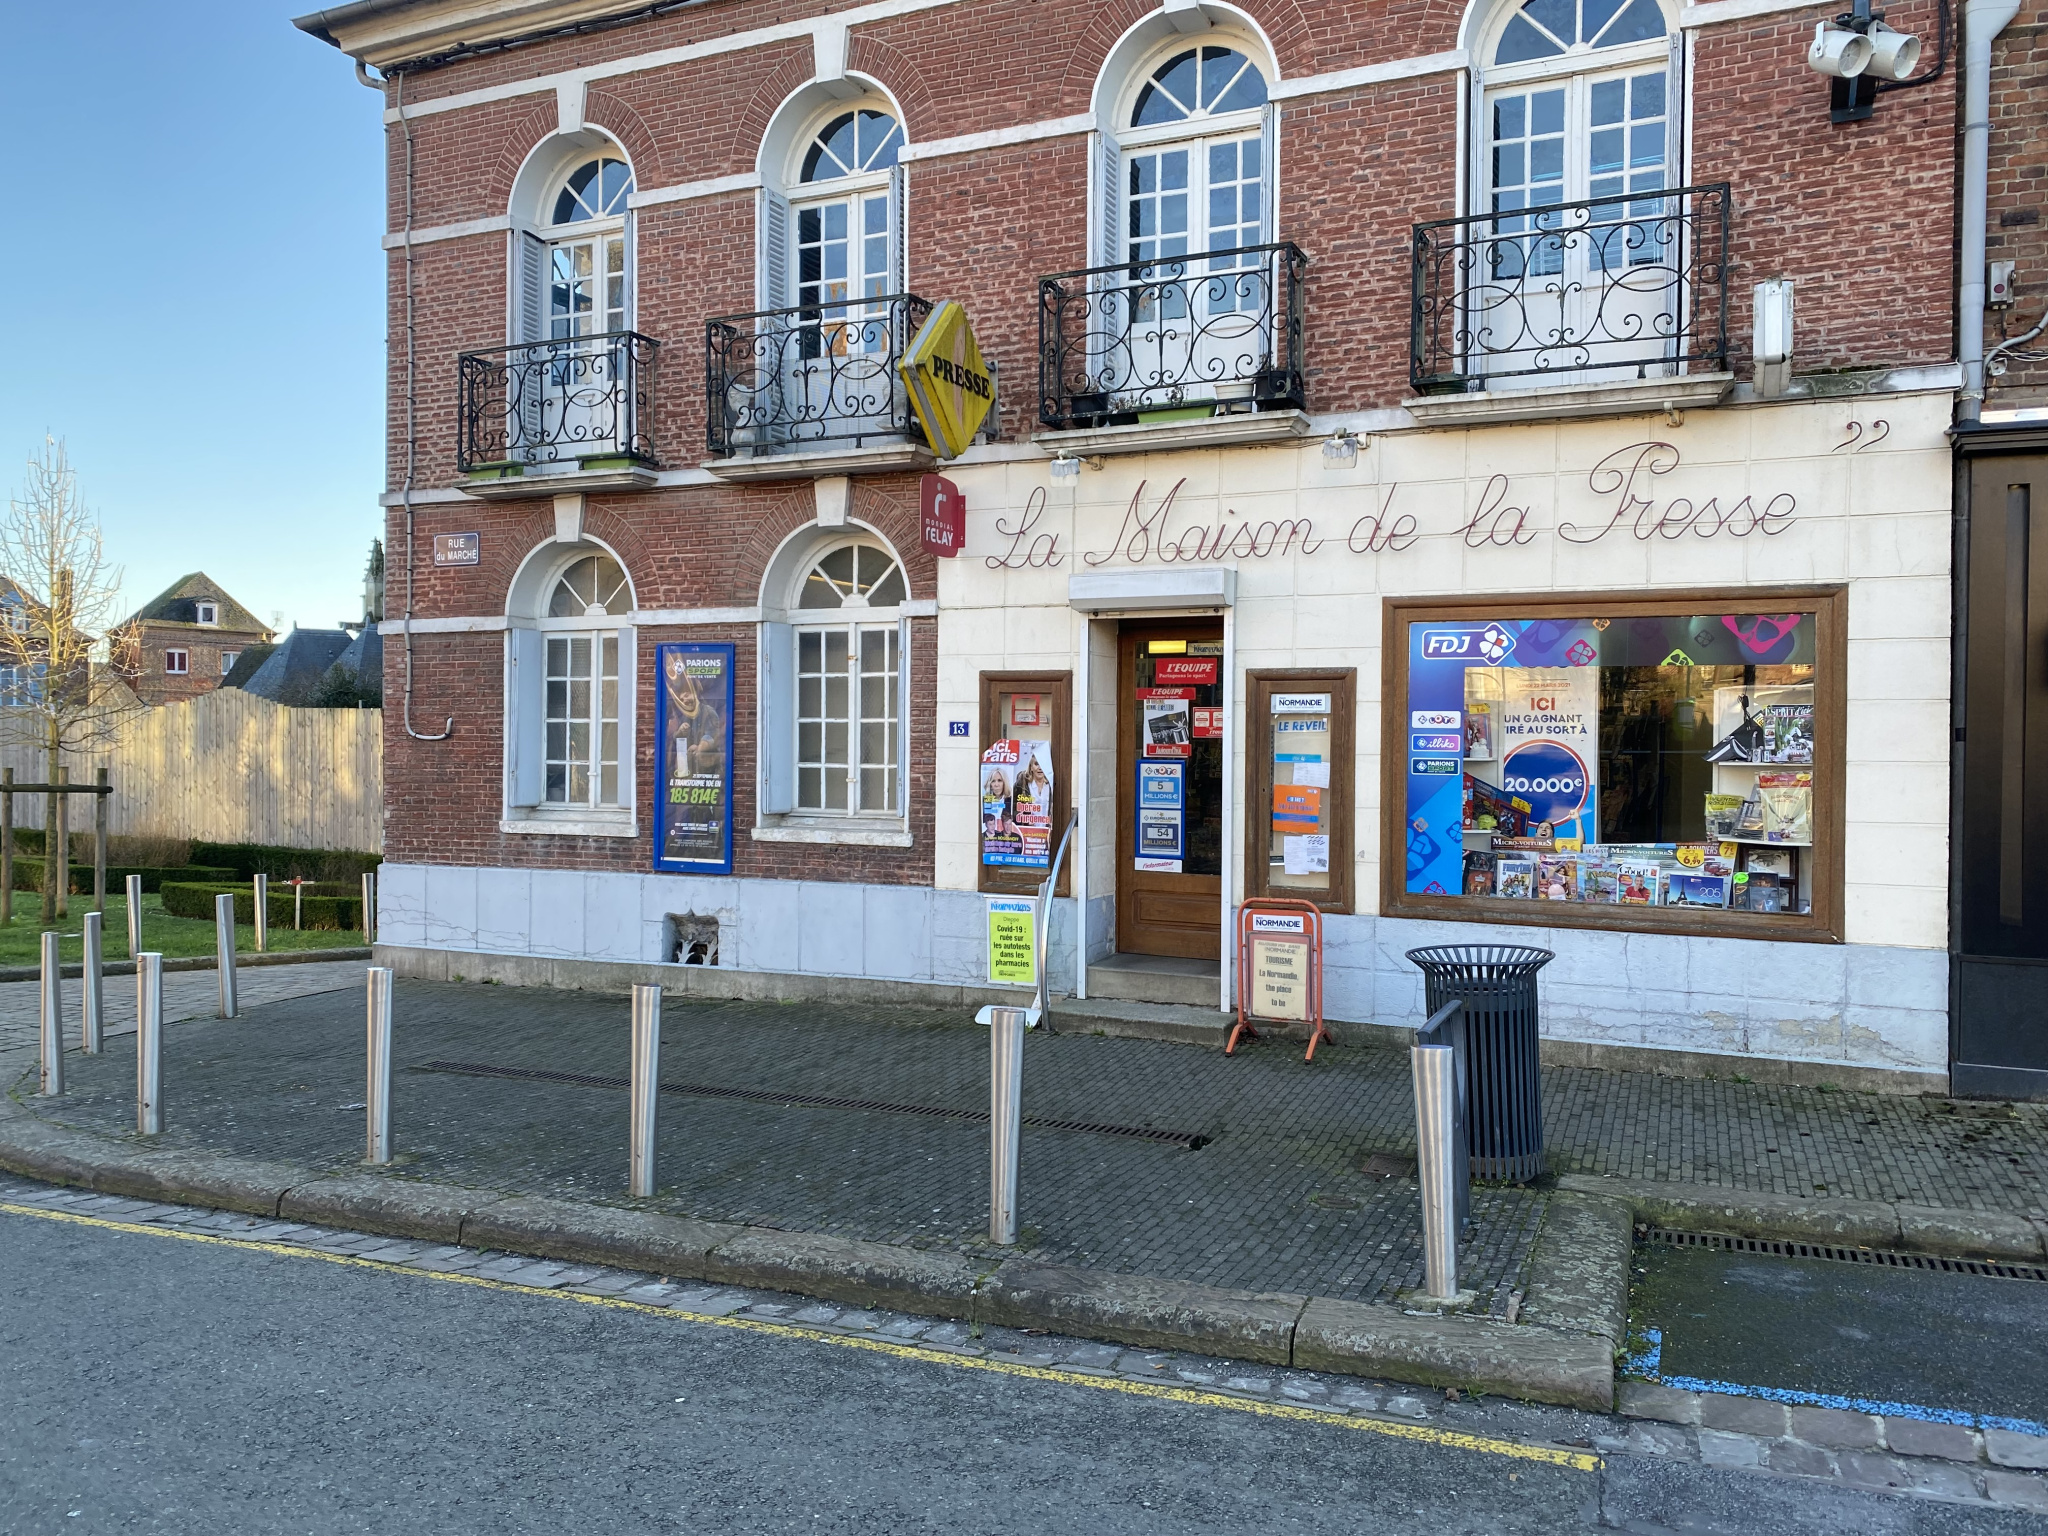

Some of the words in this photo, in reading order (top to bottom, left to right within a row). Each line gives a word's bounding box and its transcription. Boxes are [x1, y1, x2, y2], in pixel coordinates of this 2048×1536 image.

[932, 354, 990, 400] PRESSE
[985, 486, 1065, 569] La
[1084, 477, 1324, 567] Maison
[1349, 482, 1420, 554] de
[1450, 473, 1538, 548] la
[1559, 441, 1798, 544] Presse
[448, 539, 465, 548] RUE
[436, 552, 446, 560] du
[447, 548, 477, 560] MARCHÉ
[1428, 635, 1471, 654] FDJ
[1166, 662, 1214, 673] L'ÉQUIPE
[1530, 697, 1556, 711] ICI
[1429, 714, 1456, 724] LOTO
[1504, 714, 1520, 723] UN
[1523, 714, 1583, 723] GAGNANT
[952, 723, 965, 735] 13
[1278, 721, 1289, 731] LE
[1504, 724, 1524, 734] IRÉ
[1527, 725, 1543, 734] AU
[1546, 726, 1577, 734] SORT
[1579, 723, 1588, 734] À
[1427, 738, 1455, 748] illiko
[983, 749, 1018, 763] Paris
[1154, 766, 1177, 775] LOTO
[1157, 782, 1164, 790] 5
[1504, 777, 1583, 793] 20.000€
[670, 788, 690, 803] 185
[690, 788, 720, 804] 814€
[1157, 828, 1169, 837] 54
[1683, 855, 1701, 865] 6,99
[1700, 887, 1721, 898] 205
[1255, 919, 1301, 928] NORMANDIE
[997, 925, 1023, 933] Covid-19
[995, 959, 1030, 967] pharmacies
[1265, 955, 1294, 965] TOURISME
[1259, 969, 1266, 977] La
[1266, 970, 1299, 981] Normandie,
[1265, 984, 1276, 992] the
[1276, 985, 1292, 993] place
[1271, 998, 1278, 1006] to
[1278, 999, 1286, 1007] be
